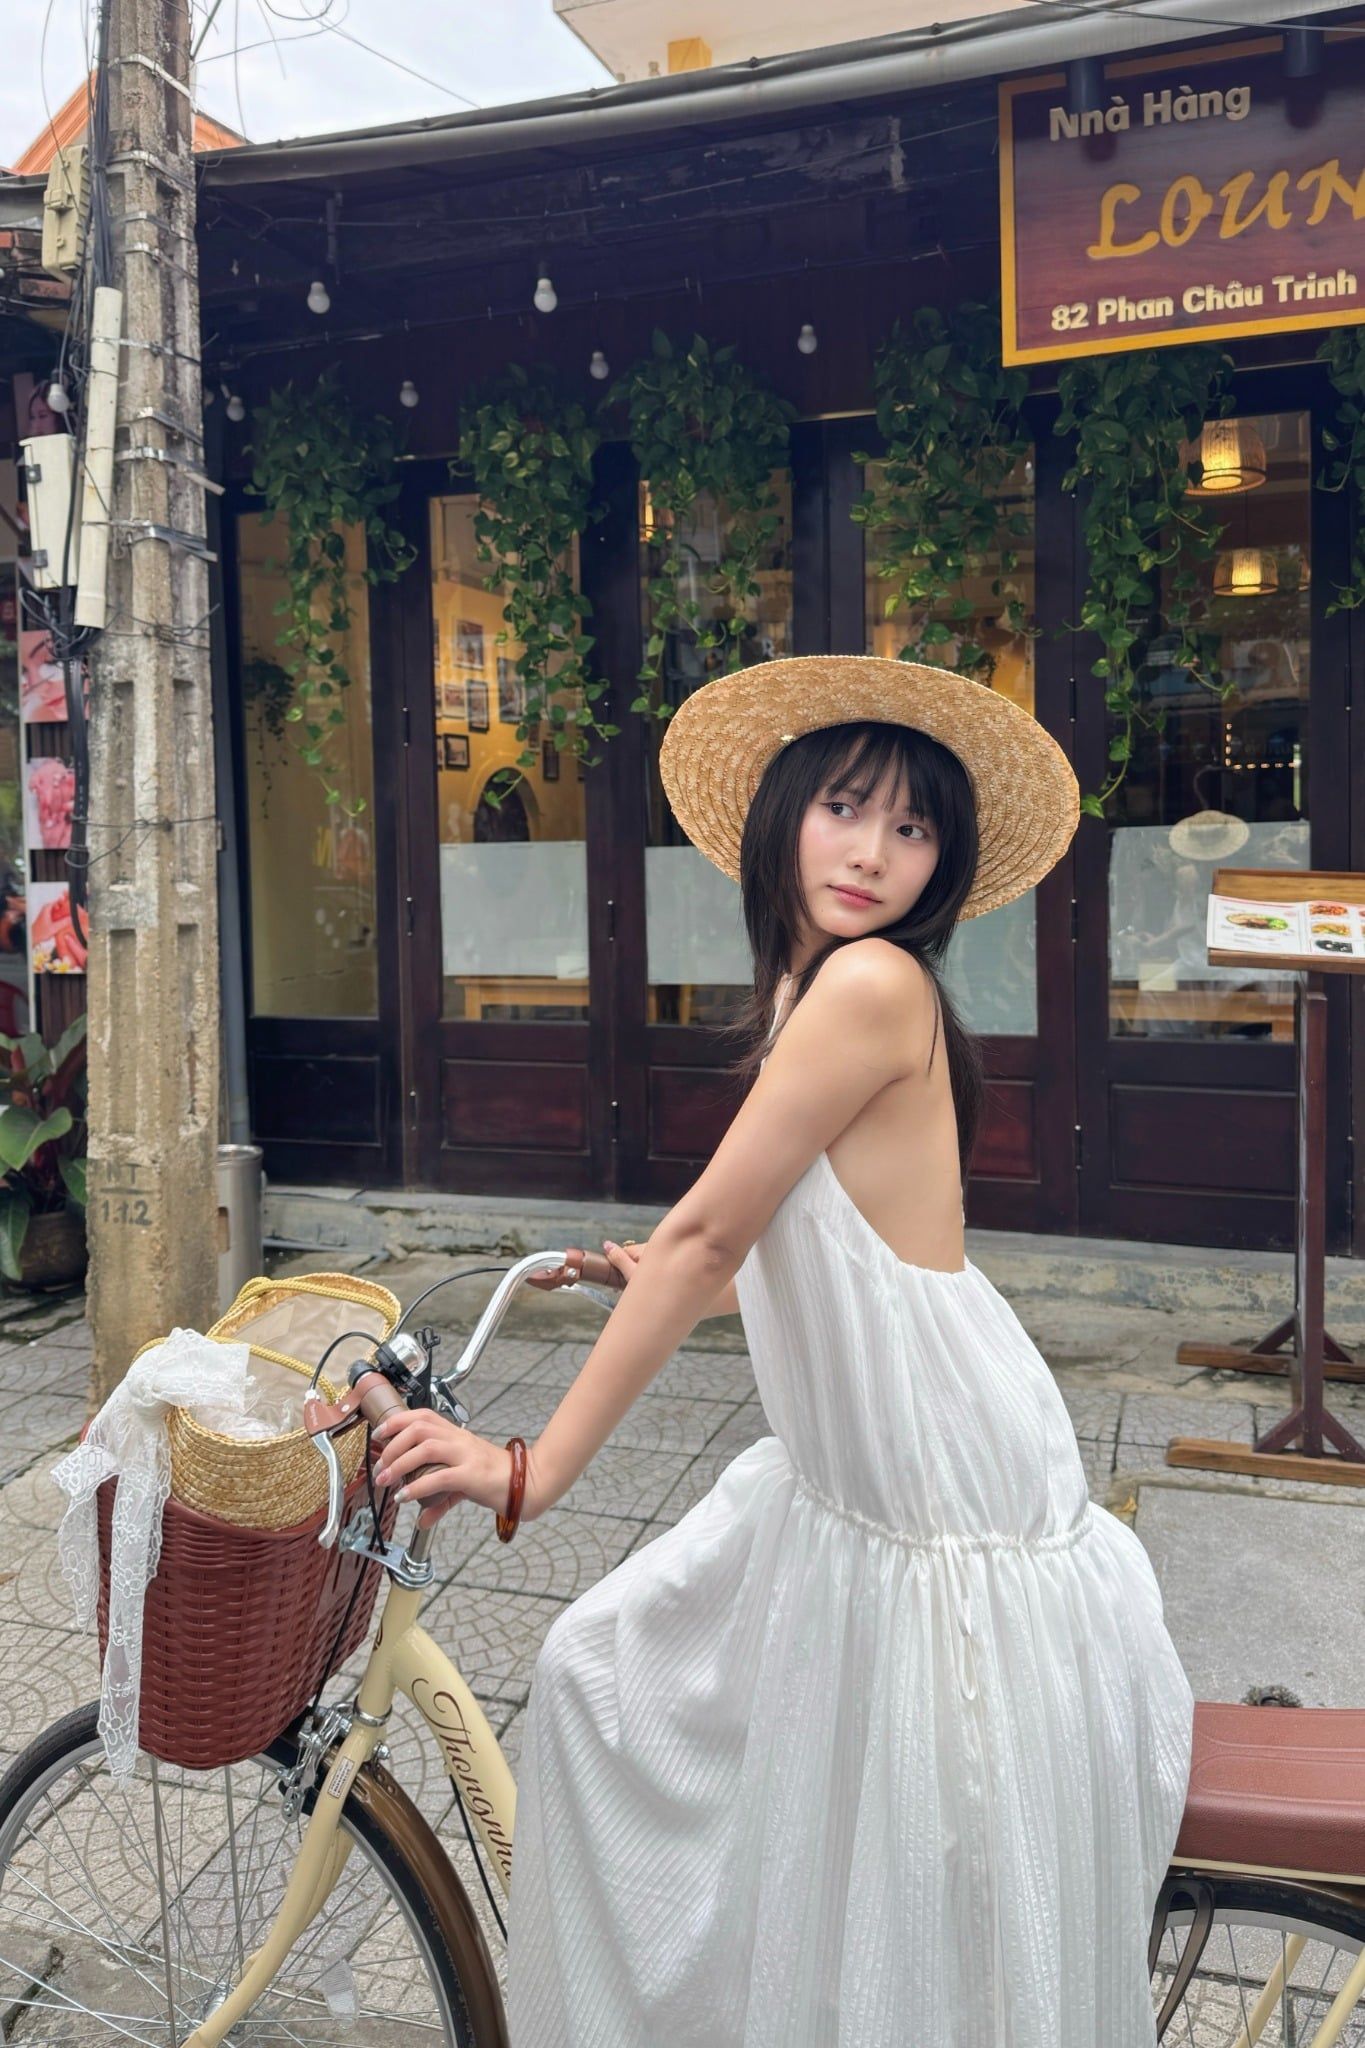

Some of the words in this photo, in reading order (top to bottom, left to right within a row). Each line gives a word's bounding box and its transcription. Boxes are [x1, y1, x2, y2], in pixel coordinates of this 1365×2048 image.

[1143, 85, 1251, 127] Hàng
[1051, 303, 1090, 331] 82
[1098, 295, 1175, 326] Phan
[1182, 279, 1264, 314] Châu
[1271, 268, 1358, 303] Trinh
